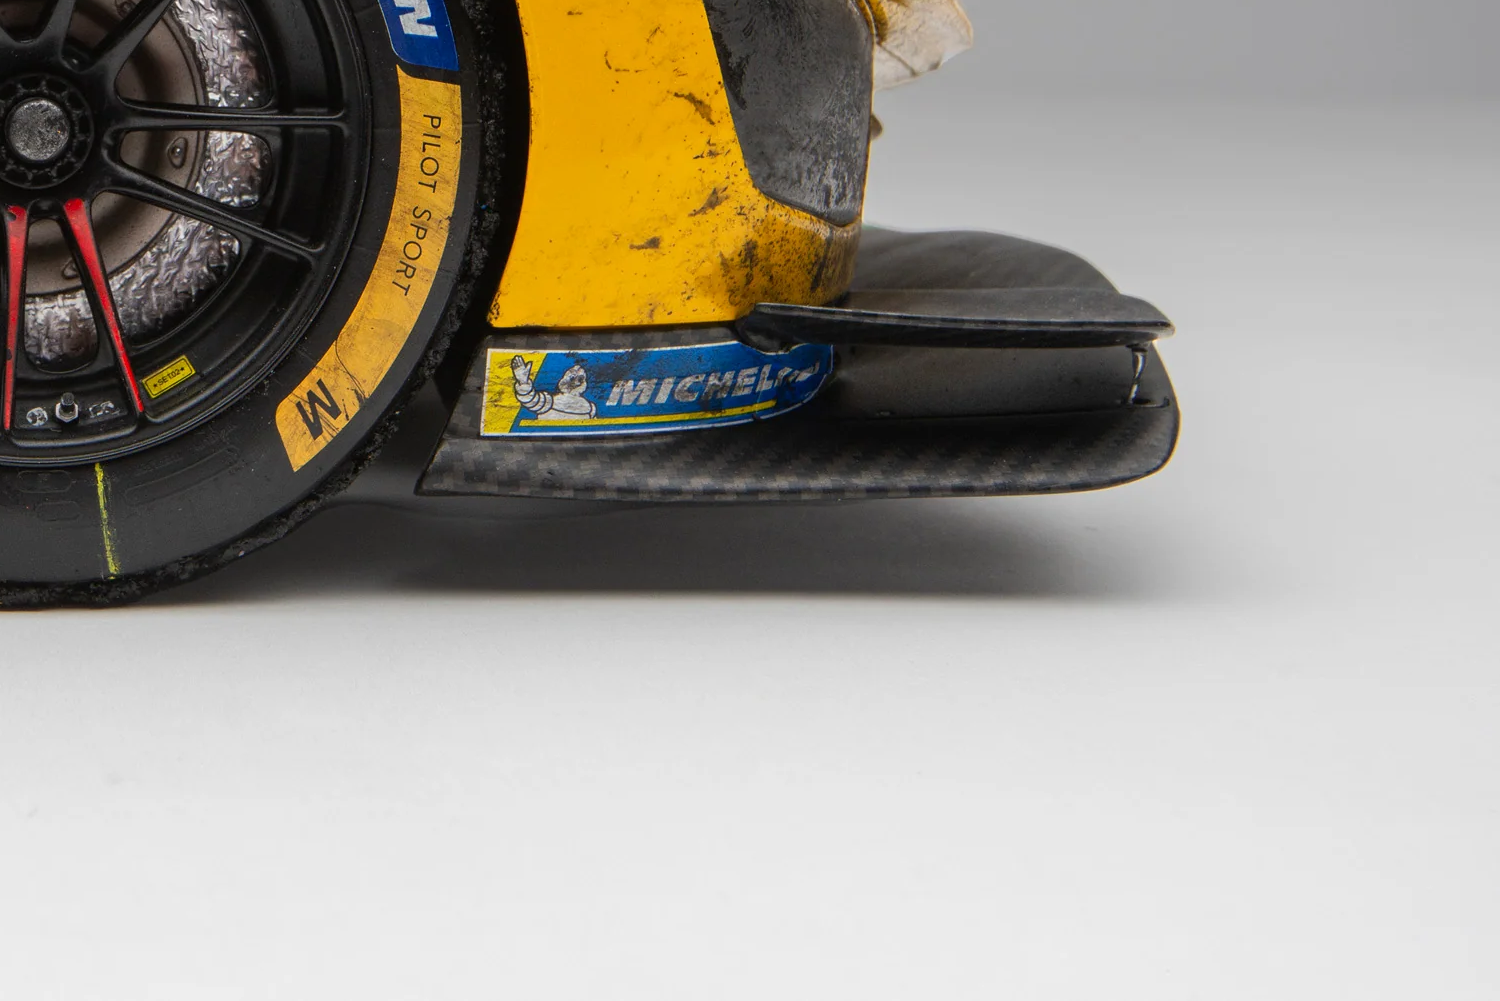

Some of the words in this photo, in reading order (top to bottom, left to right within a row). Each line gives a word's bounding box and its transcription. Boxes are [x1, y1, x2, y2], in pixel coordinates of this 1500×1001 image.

[417, 113, 442, 194] PILOT
[394, 207, 431, 297] SPORT
[295, 379, 339, 440] M
